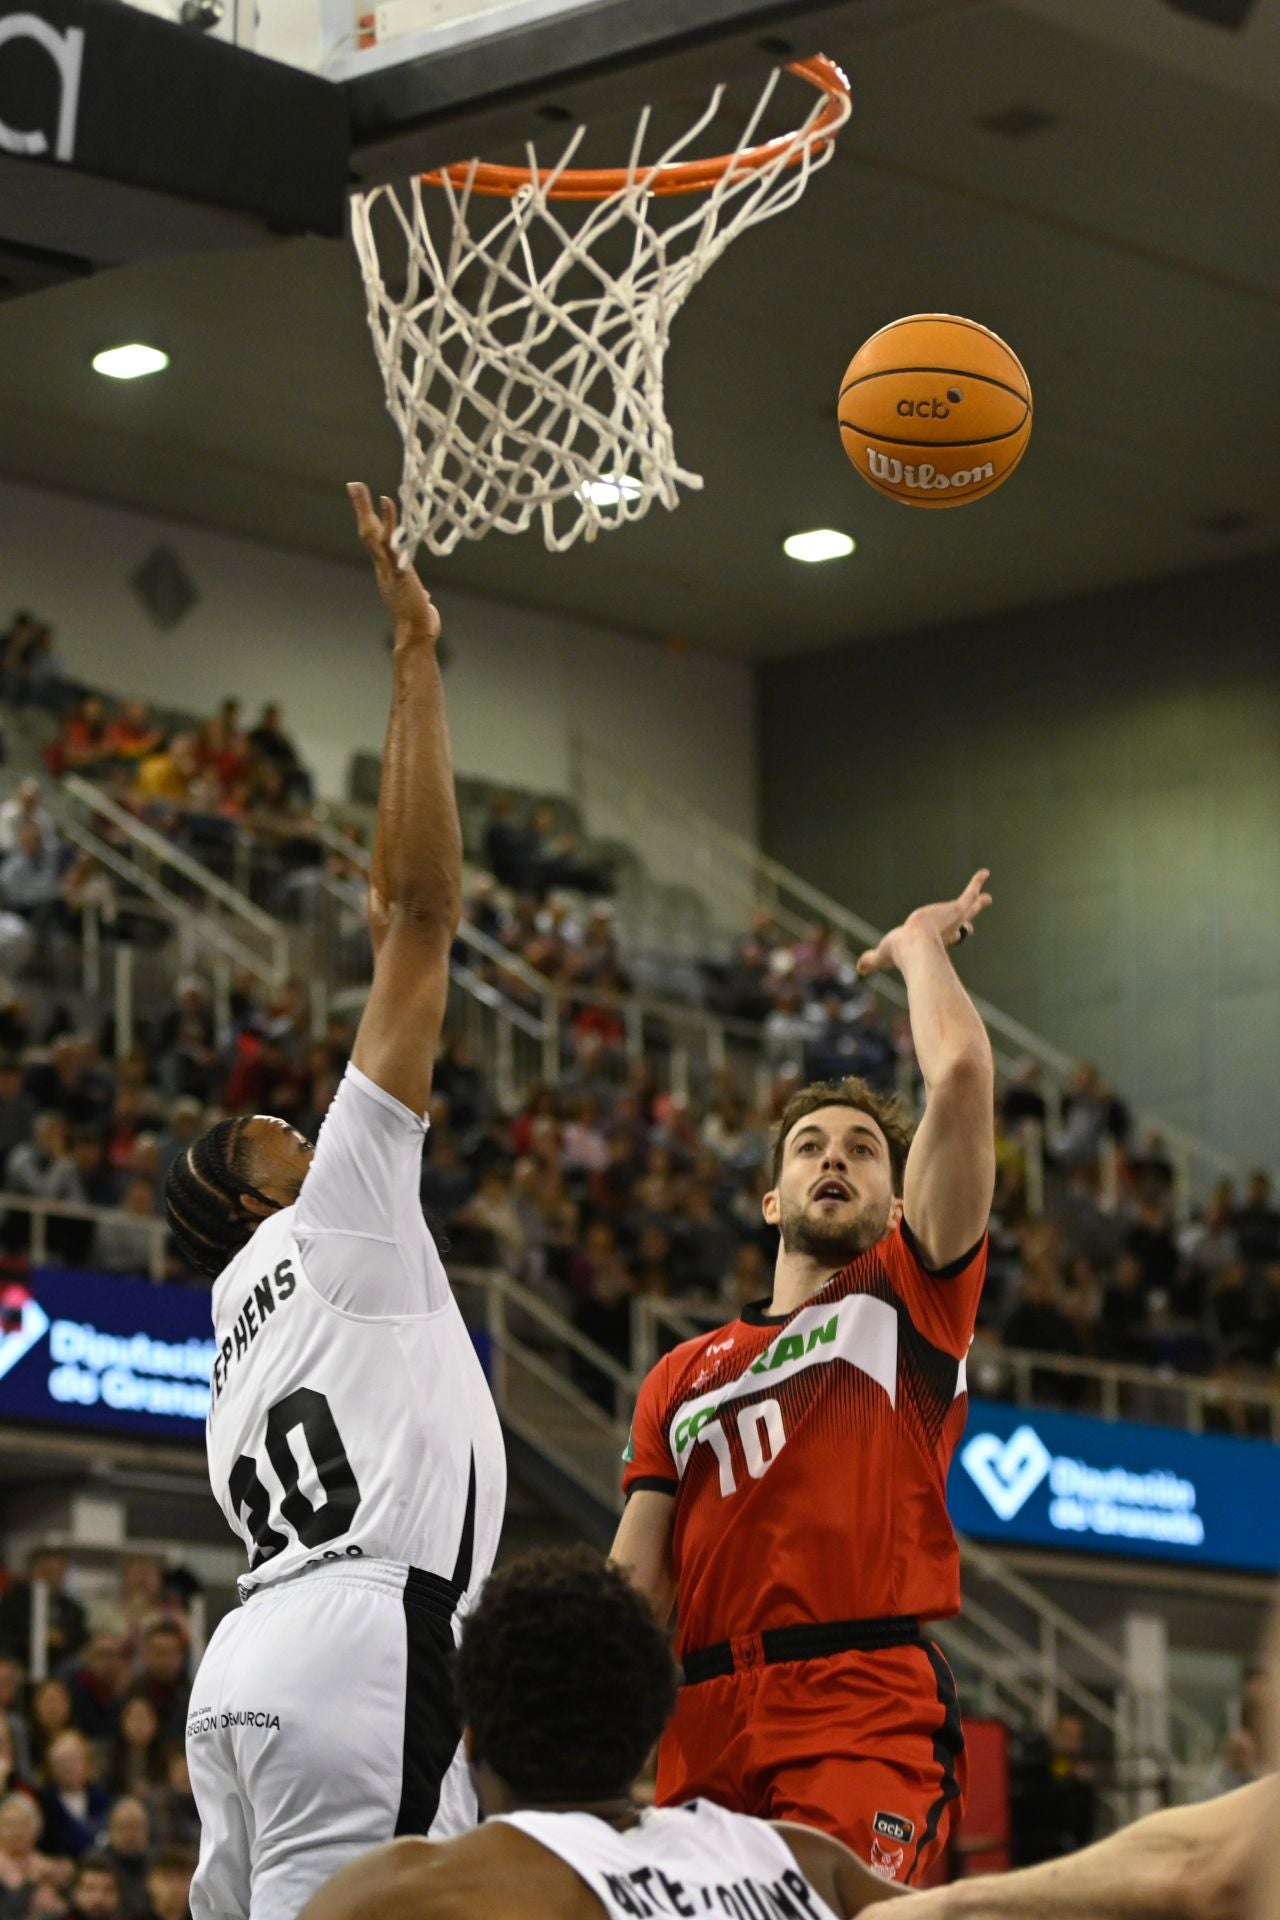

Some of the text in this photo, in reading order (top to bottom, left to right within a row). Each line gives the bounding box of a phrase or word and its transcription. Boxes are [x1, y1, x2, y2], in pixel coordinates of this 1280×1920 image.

[896, 397, 950, 420] acb
[866, 447, 994, 489] Wilson
[697, 1399, 786, 1498] 10
[877, 1819, 905, 1839] acb
